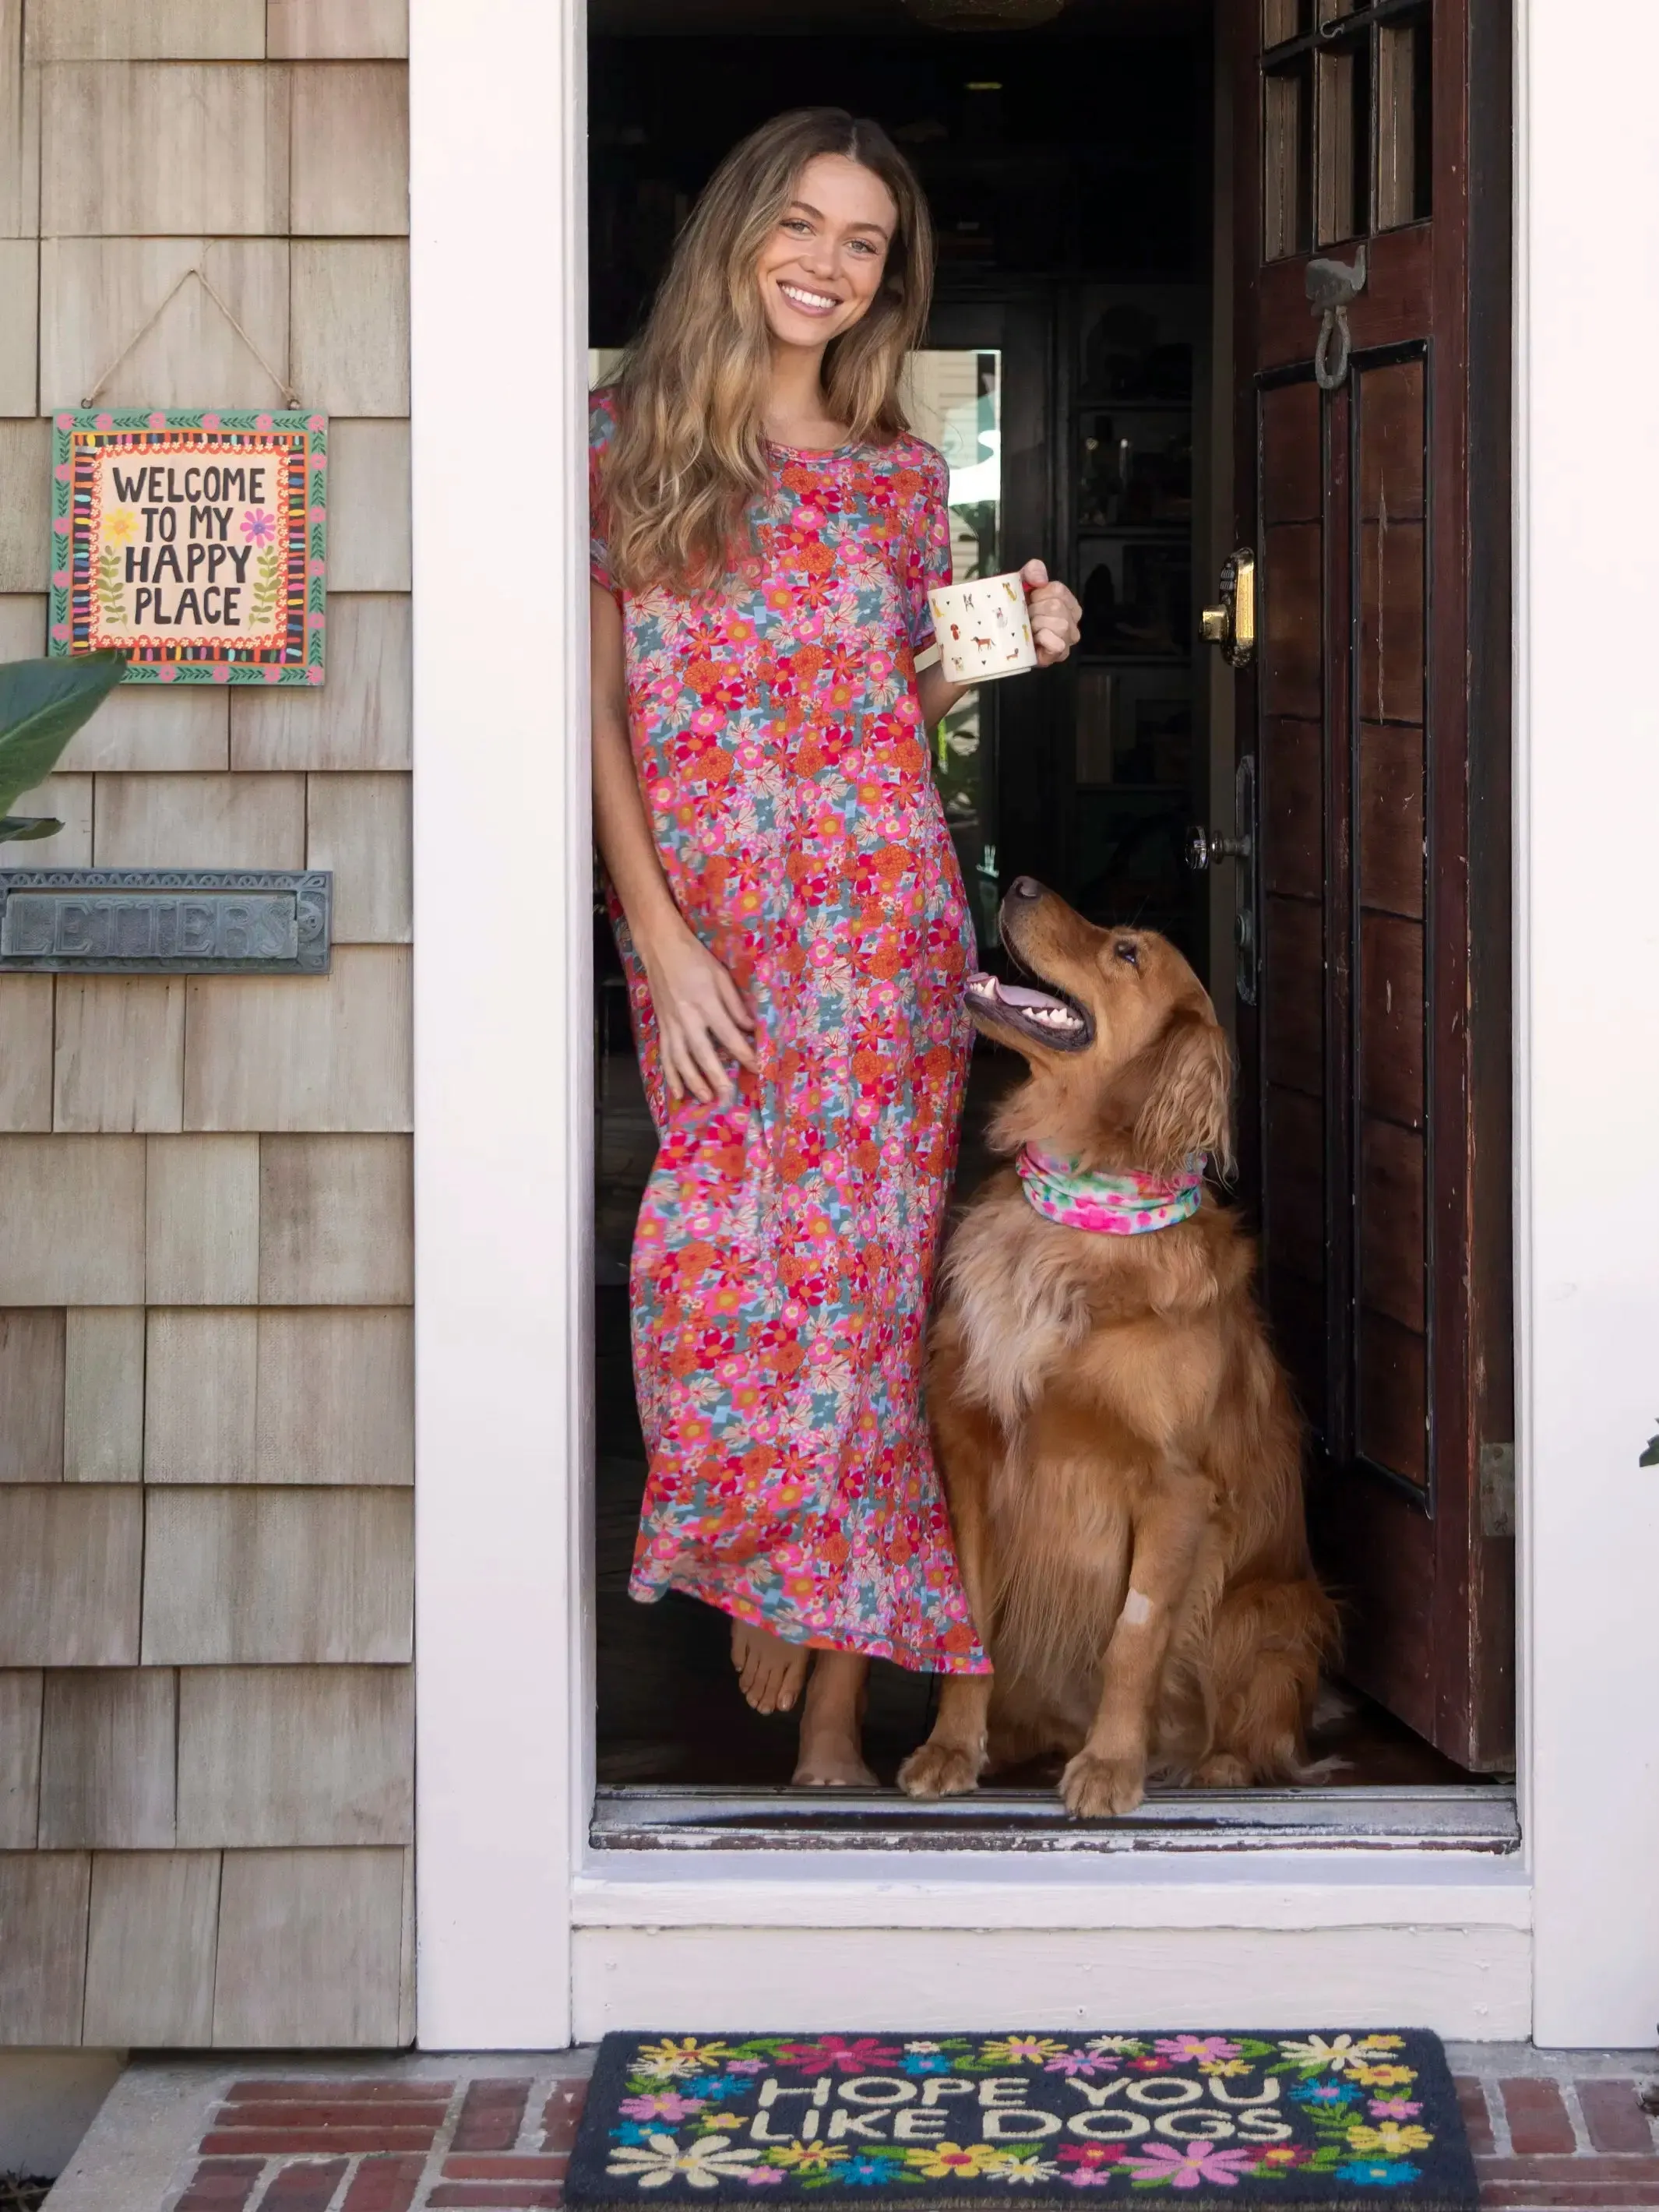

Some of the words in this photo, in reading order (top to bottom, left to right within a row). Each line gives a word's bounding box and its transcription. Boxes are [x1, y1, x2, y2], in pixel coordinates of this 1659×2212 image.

[112, 467, 266, 504] WELCOME
[141, 506, 177, 543] TO
[189, 505, 234, 541] MY
[125, 543, 252, 584] HAPPY
[134, 586, 241, 625] PLACE
[12, 897, 288, 956] LETTERS
[758, 2076, 1030, 2107] HOPE
[1065, 2076, 1280, 2107] YOU
[749, 2108, 949, 2140] LIKE
[982, 2108, 1293, 2141] DOGS
